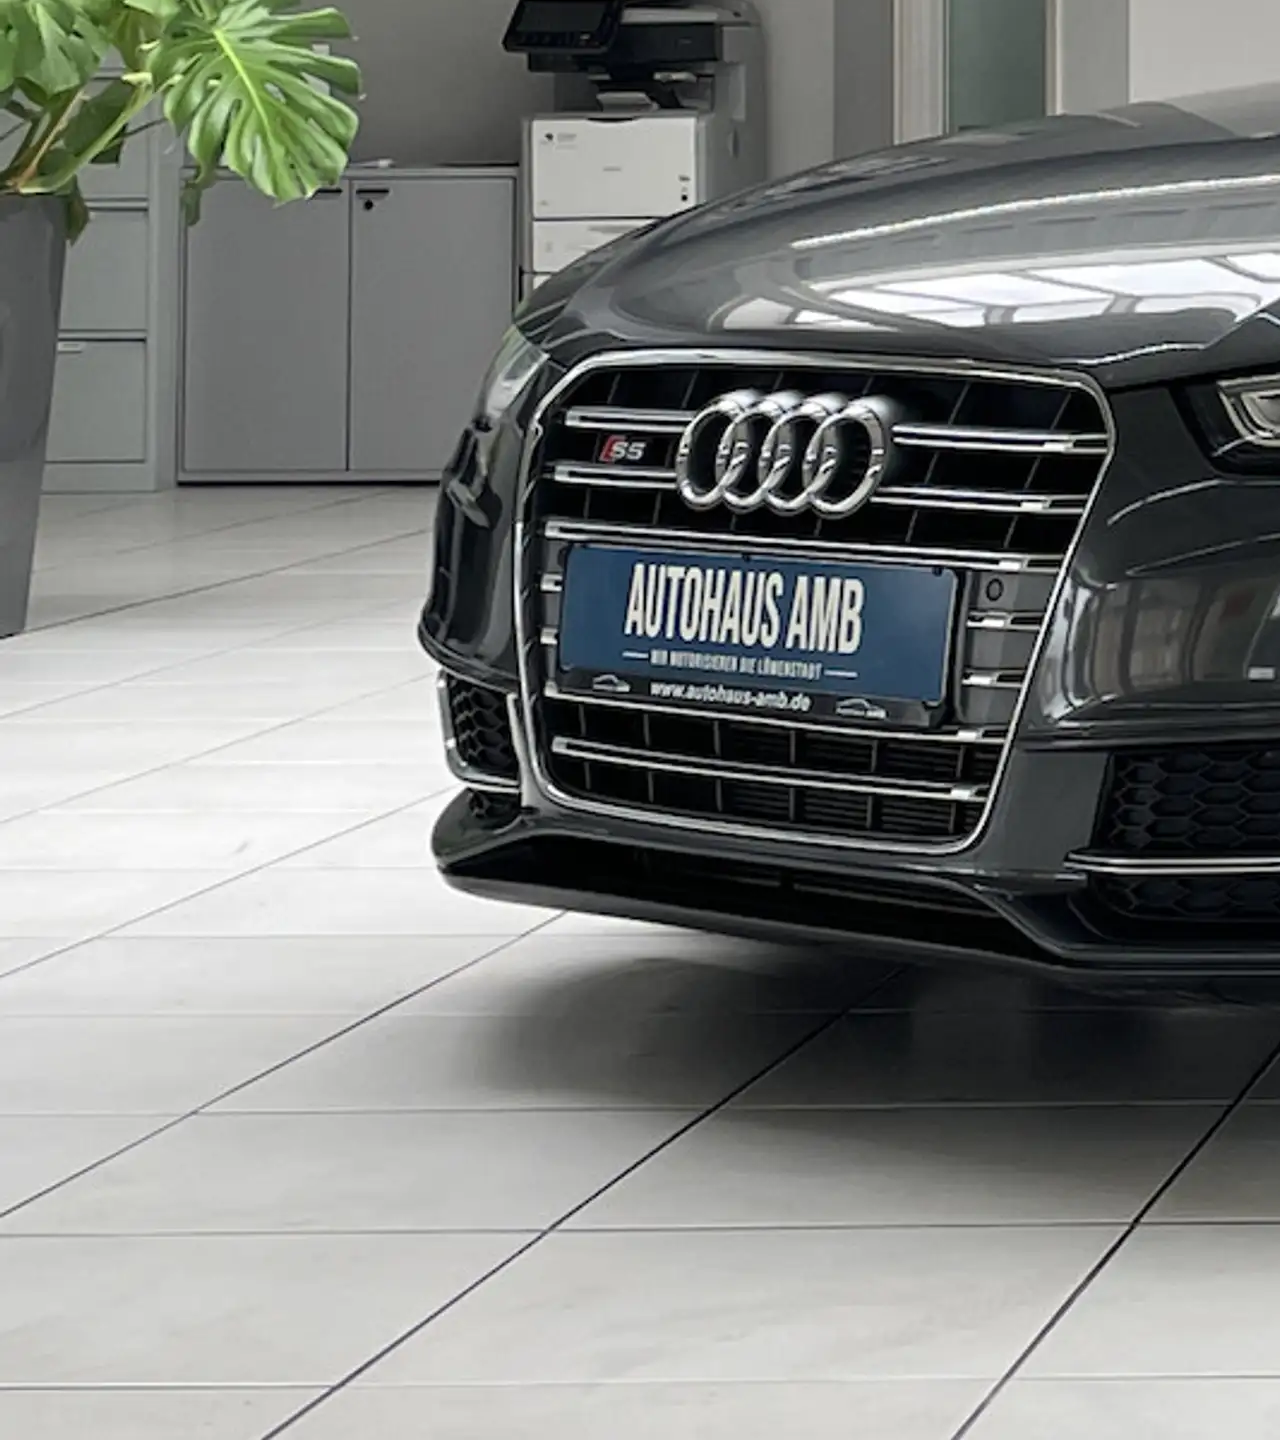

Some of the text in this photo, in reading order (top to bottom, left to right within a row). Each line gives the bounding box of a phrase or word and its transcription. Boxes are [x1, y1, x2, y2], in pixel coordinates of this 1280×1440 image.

[607, 440, 647, 462] S5
[624, 563, 863, 655] AUTOHAUS AMB
[650, 648, 823, 681] WIR MOTORISIEREN DIE LÖWENSTADT
[650, 682, 811, 711] www.autohaus-amb.de
